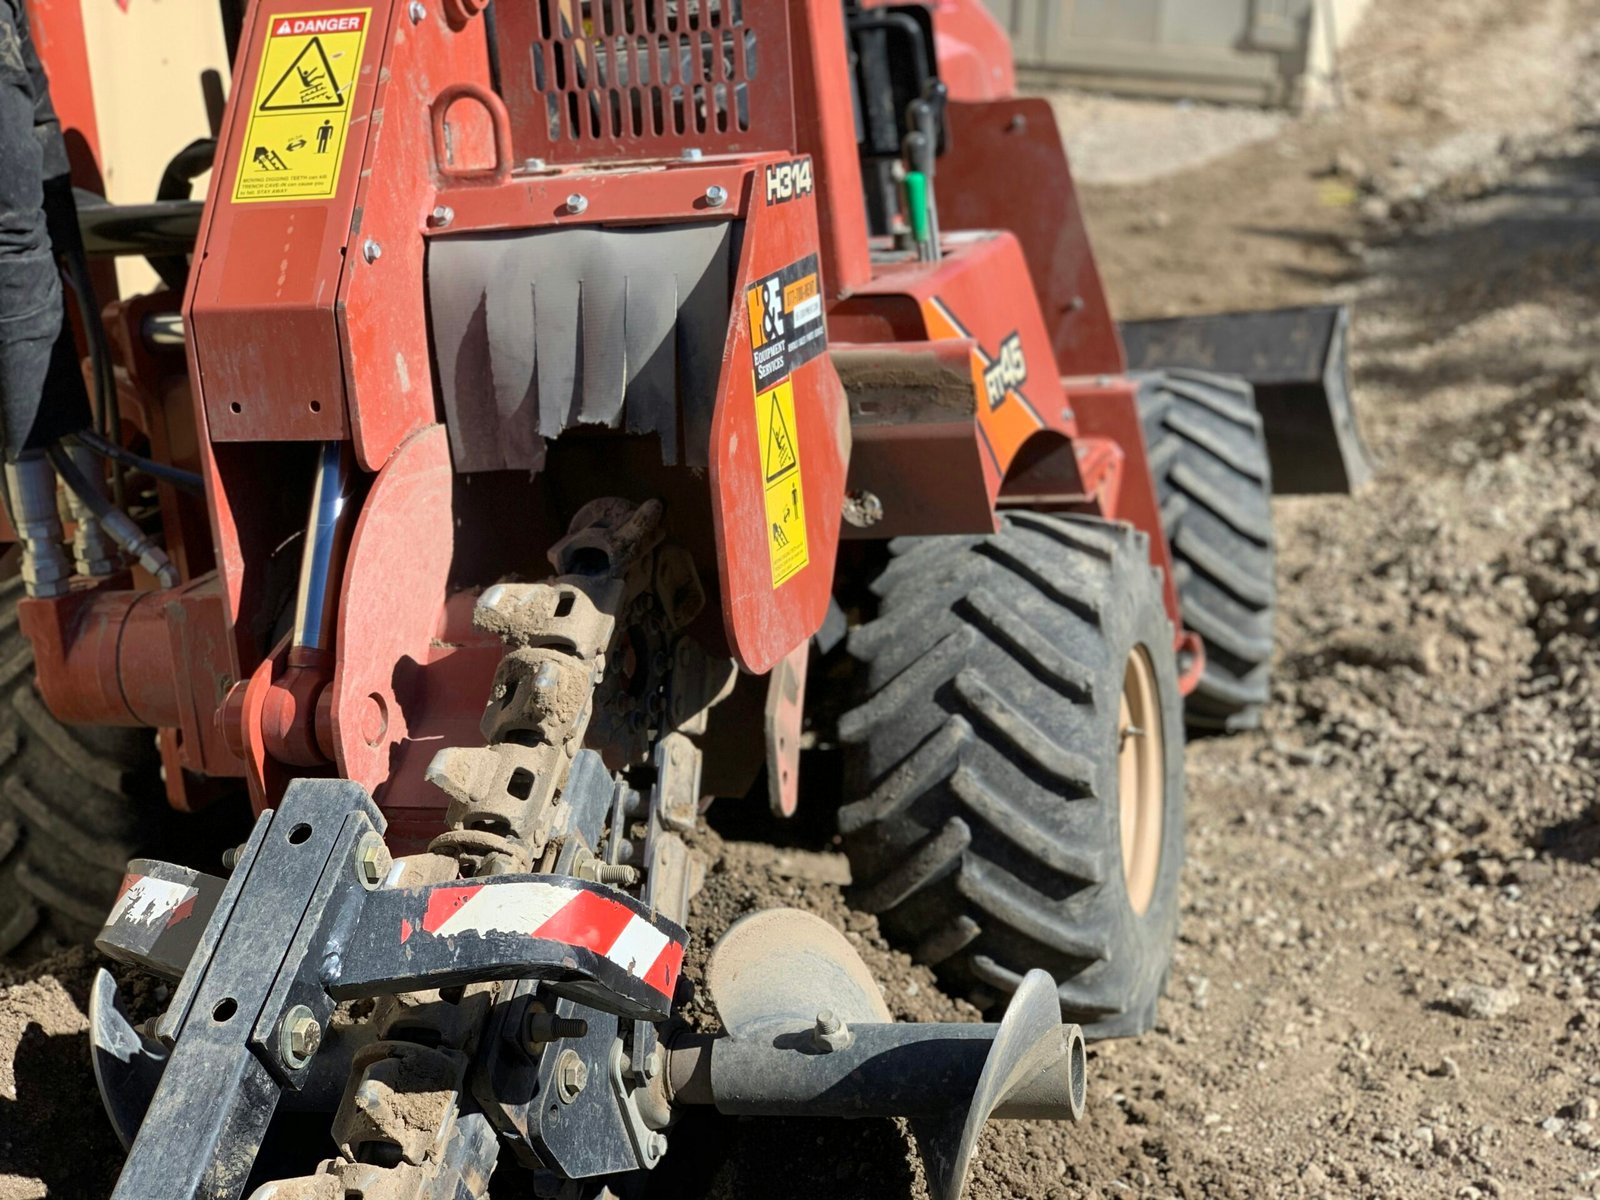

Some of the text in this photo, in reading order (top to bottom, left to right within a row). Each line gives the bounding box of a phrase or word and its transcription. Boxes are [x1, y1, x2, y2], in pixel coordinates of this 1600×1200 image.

[293, 17, 360, 34] DANGER
[766, 160, 812, 202] H314
[753, 340, 786, 367] EQUIPMENT
[758, 356, 785, 380] SERVICES
